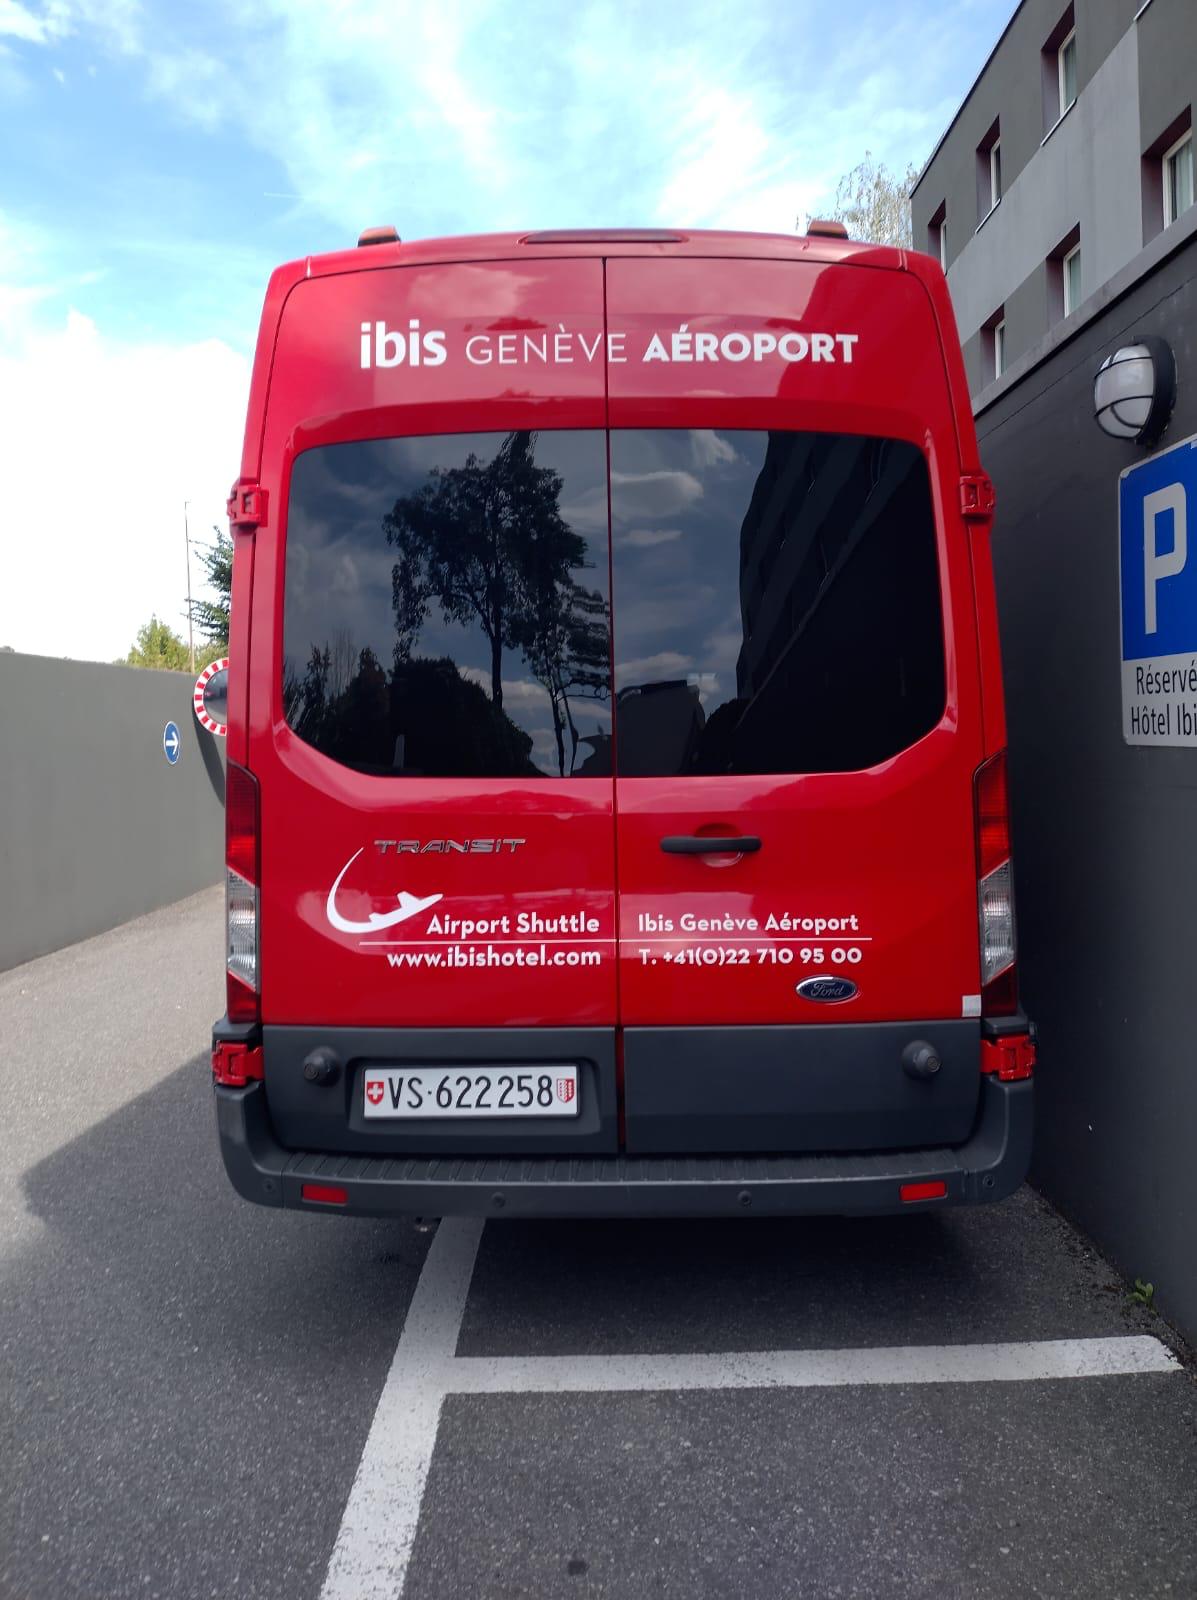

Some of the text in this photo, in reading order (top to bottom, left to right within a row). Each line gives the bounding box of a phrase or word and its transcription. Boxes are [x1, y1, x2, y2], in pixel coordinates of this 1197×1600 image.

[360, 319, 859, 369] ibis GENÈVE AÉROPORT
[1143, 482, 1187, 635] P
[1136, 660, 1197, 695] Réservé
[1131, 703, 1170, 735] Hôtel
[373, 838, 527, 855] TRANSIT
[426, 914, 510, 939] Airport
[516, 911, 600, 934] Shuttle
[638, 912, 859, 935] Ibis Genève Aéroport
[387, 944, 601, 967] www.ibishotel.com
[639, 946, 863, 967] T. +41(0)22 710 95 00
[810, 982, 845, 997] Ford
